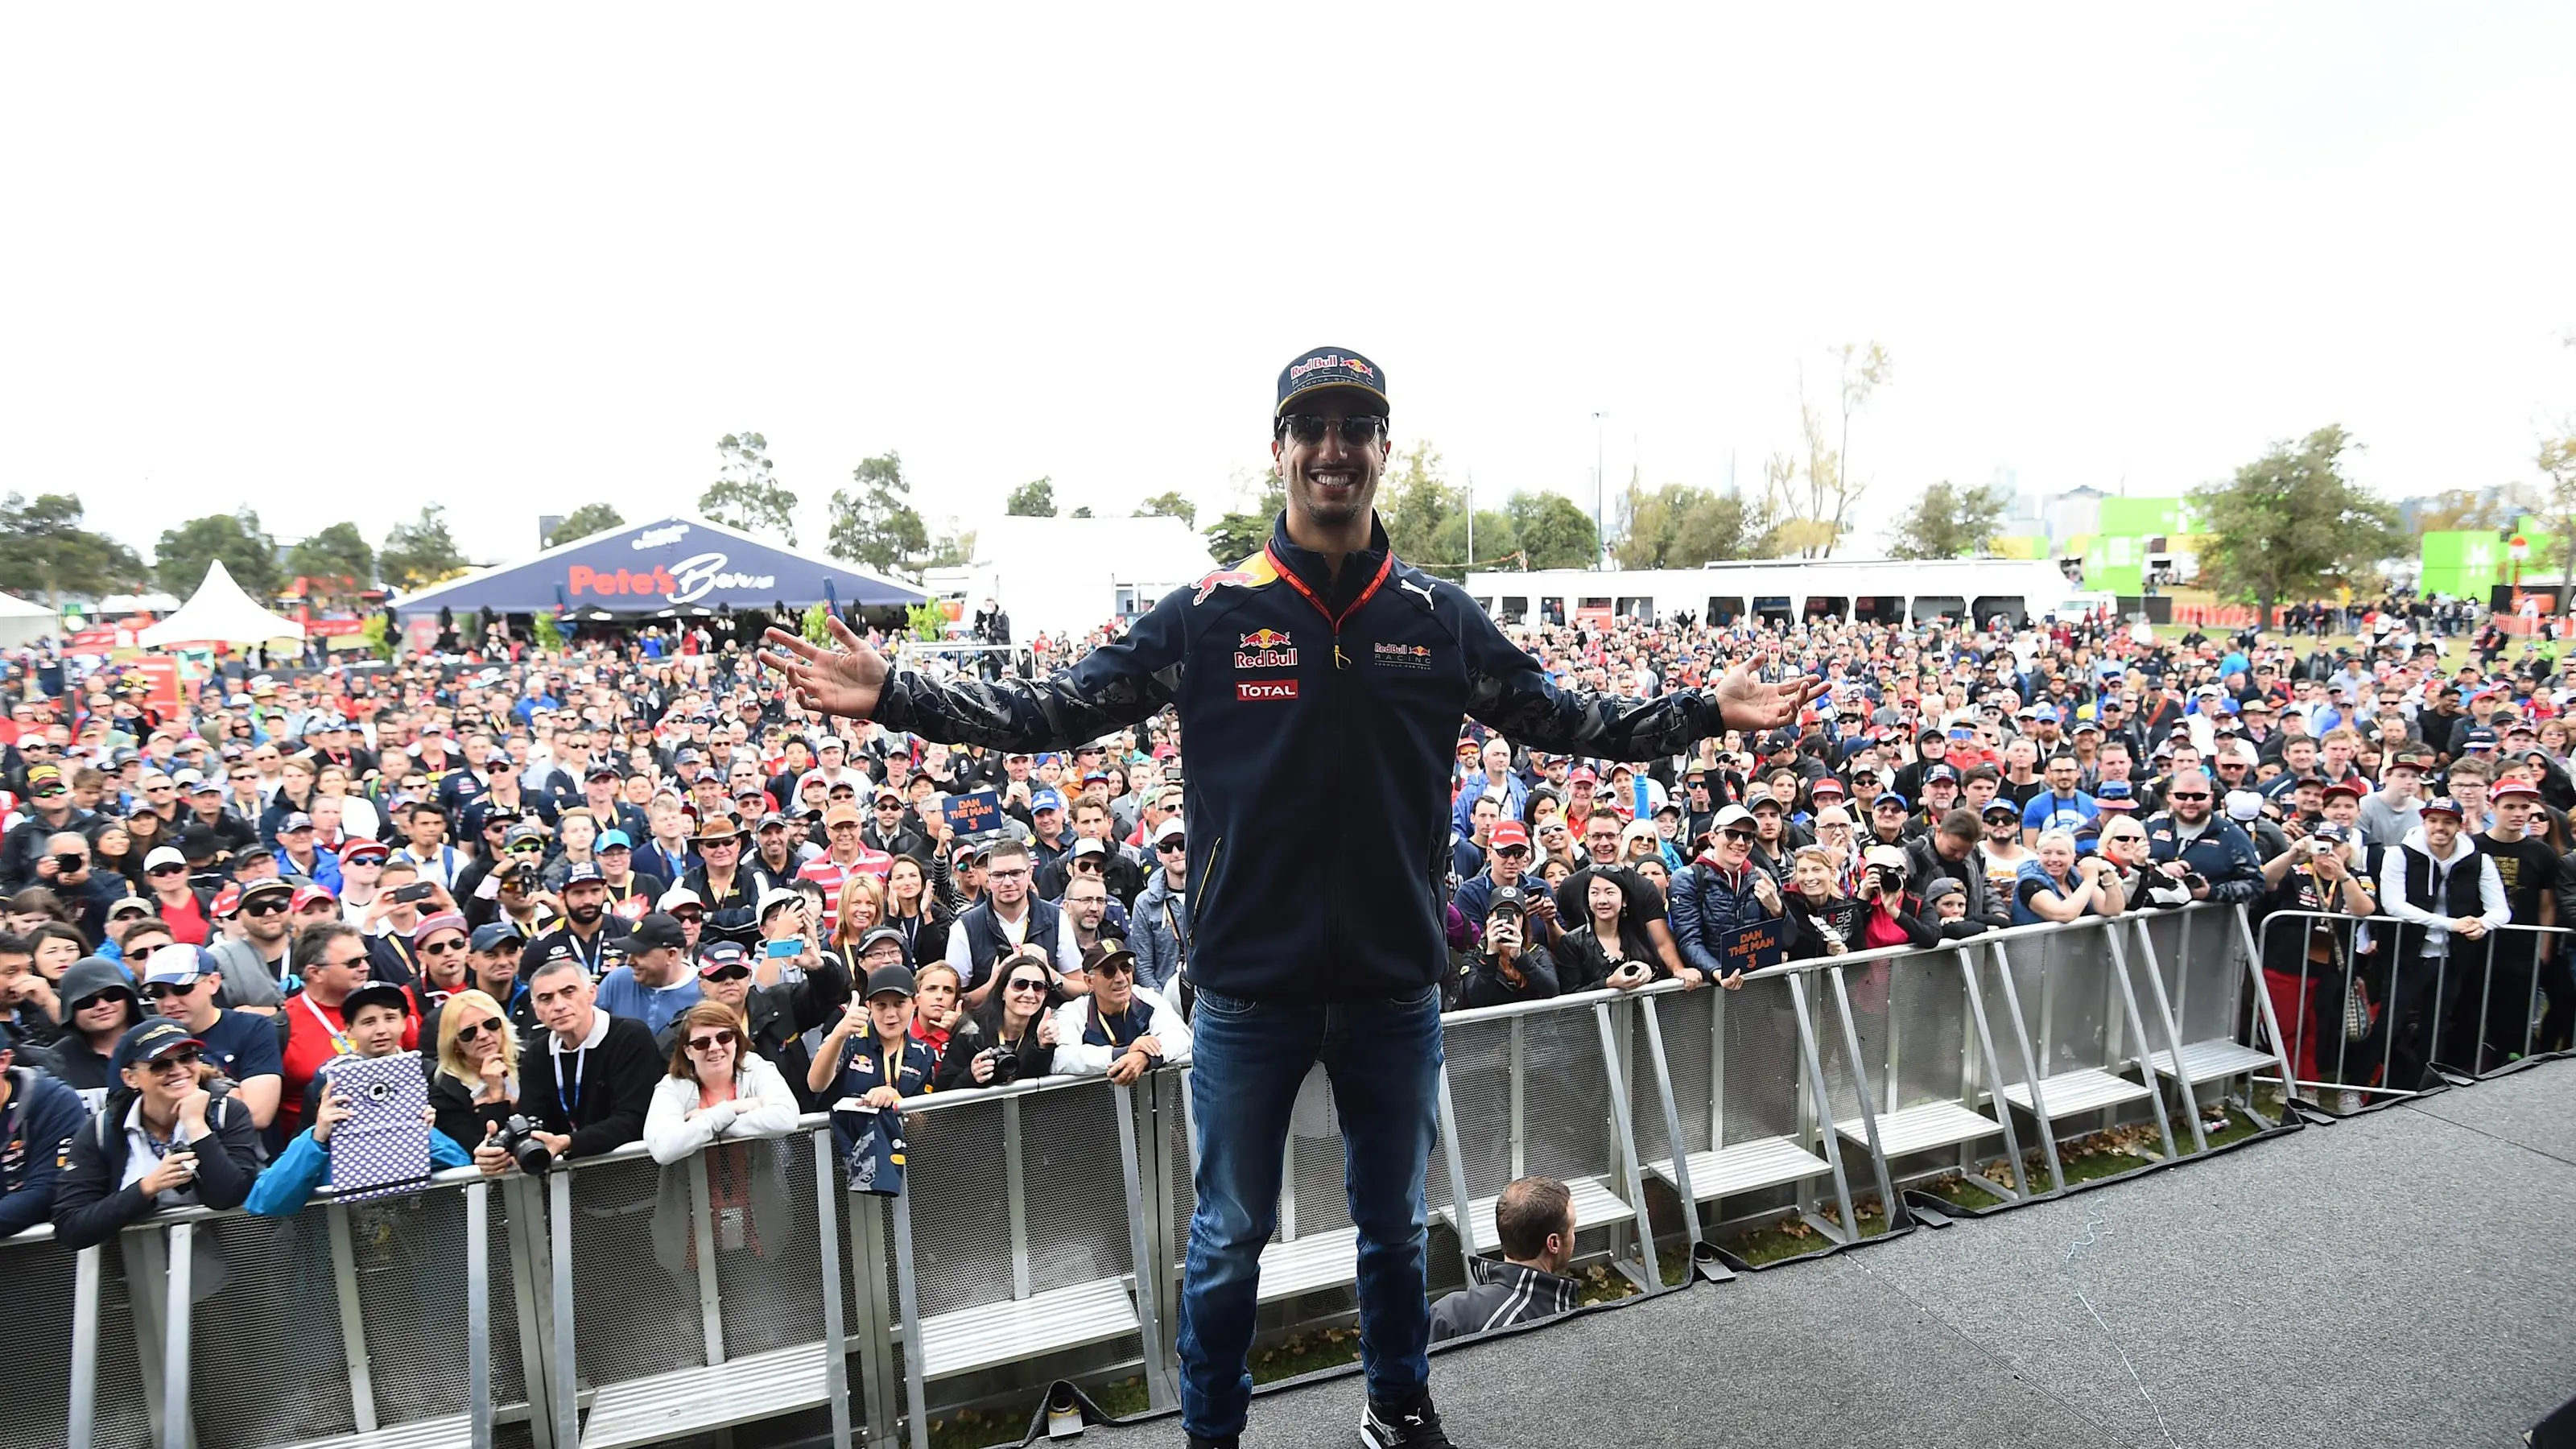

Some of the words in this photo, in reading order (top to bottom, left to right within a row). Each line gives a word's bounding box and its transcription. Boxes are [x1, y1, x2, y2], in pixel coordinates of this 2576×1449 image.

[1290, 358, 1312, 380] Red
[1313, 355, 1337, 369] Bull
[1291, 368, 1374, 387] RACING
[568, 565, 677, 596] Pete's
[1374, 642, 1391, 654] Red
[1390, 644, 1408, 655] Bull
[1234, 650, 1266, 669] Red
[1266, 648, 1298, 667] Bull
[1374, 654, 1431, 664] RACING
[1238, 683, 1296, 697] TOTAL
[958, 798, 980, 810] DAN
[948, 808, 968, 820] THE
[968, 805, 993, 817] MAN
[968, 818, 978, 830] 3
[1740, 929, 1763, 944] DAN
[1728, 943, 1749, 957] THE
[1750, 936, 1774, 952] MAN
[1747, 953, 1757, 968] 3
